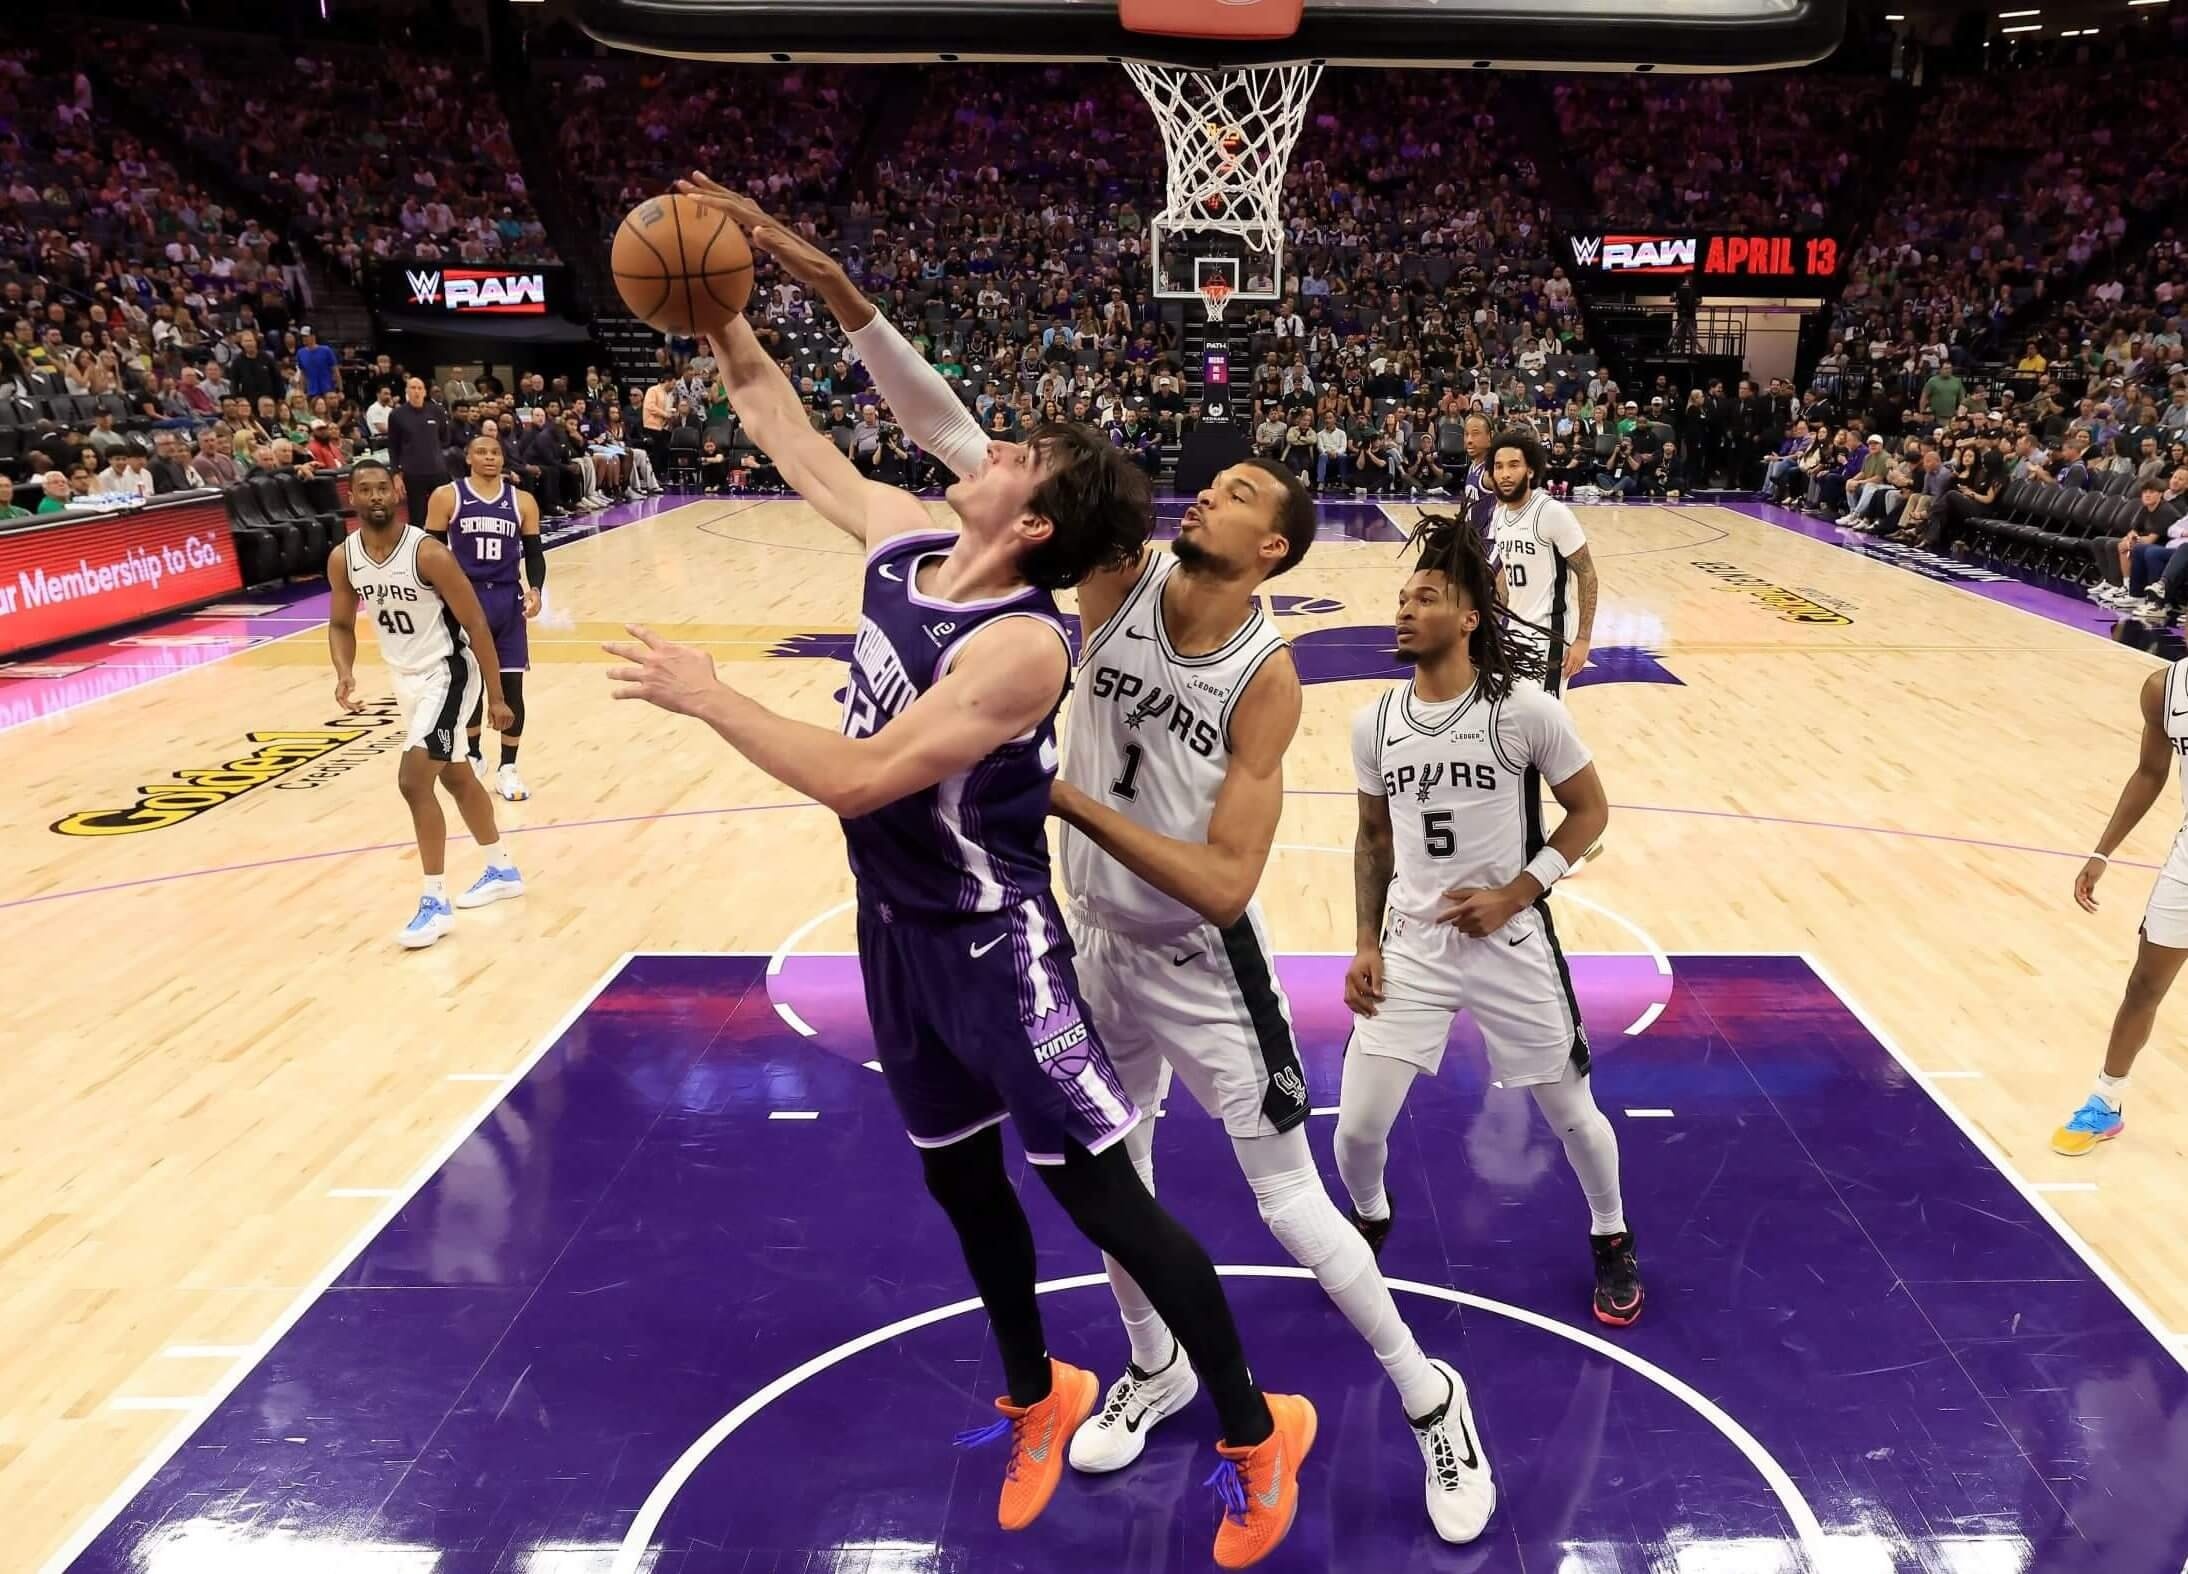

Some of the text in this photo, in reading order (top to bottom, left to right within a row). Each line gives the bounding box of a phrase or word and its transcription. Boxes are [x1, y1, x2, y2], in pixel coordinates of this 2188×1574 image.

[1602, 239, 1696, 270] RAW
[1704, 237, 1795, 274] APRIL
[1806, 238, 1837, 275] 13
[444, 275, 545, 309] RAW
[460, 516, 516, 538] SACRAMENTO
[475, 536, 502, 560] 18
[1498, 540, 1536, 558] PURS
[18, 546, 162, 609] Membership
[162, 545, 187, 575] to
[1690, 562, 1774, 586] CENTER
[378, 609, 415, 635] 40
[1193, 679, 1224, 698] LEDGER
[1093, 667, 1218, 757] SPURS
[274, 757, 369, 790] Credit
[1109, 742, 1144, 803] 1
[1384, 762, 1496, 803] SPURS
[1421, 808, 1458, 860] 5
[1033, 1023, 1088, 1064] KINGS
